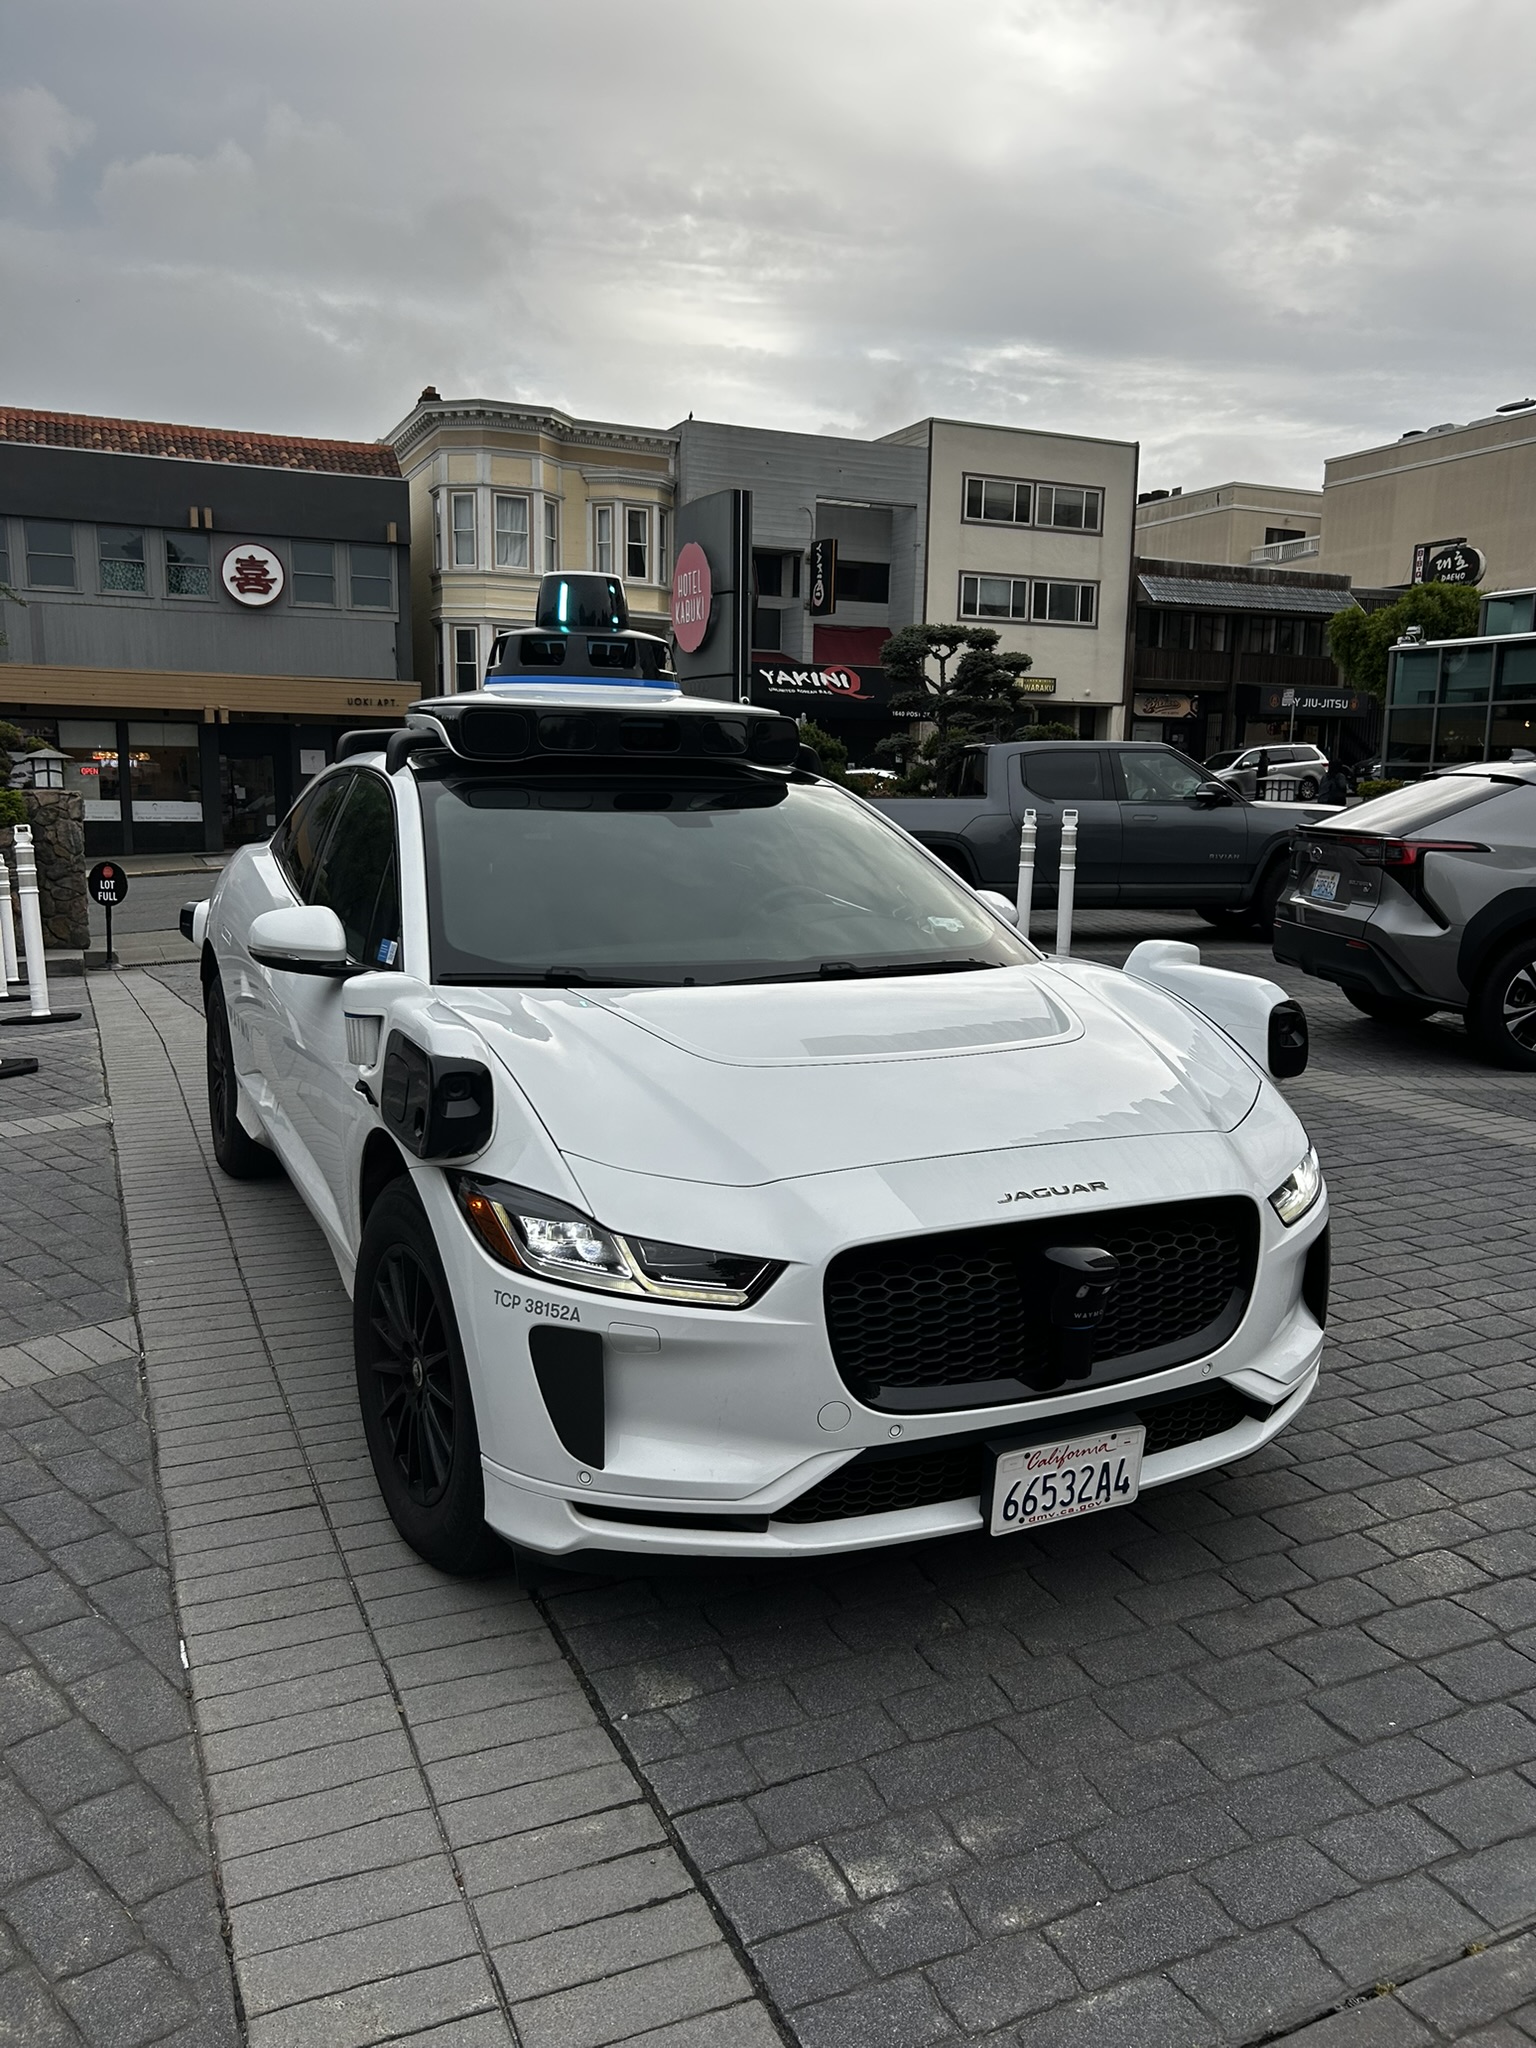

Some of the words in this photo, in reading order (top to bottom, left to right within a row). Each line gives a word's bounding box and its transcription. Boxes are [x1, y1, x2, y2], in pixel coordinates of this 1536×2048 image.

[229, 554, 277, 595] 喜
[678, 570, 702, 598] HOTEL
[675, 596, 705, 625] KABUKI
[1024, 684, 1055, 692] WARAKU
[1302, 697, 1349, 710] JIU-JITSU
[81, 767, 99, 776] OPEN
[97, 891, 118, 901] FULL
[100, 880, 115, 890] LOT
[997, 1181, 1109, 1204] JAGUAR
[494, 1289, 521, 1310] TCP
[525, 1298, 581, 1323] 38152A
[1026, 1442, 1117, 1470] California
[1002, 1457, 1130, 1522] 66532A4
[1028, 1500, 1103, 1523] dmv.ca.gov
